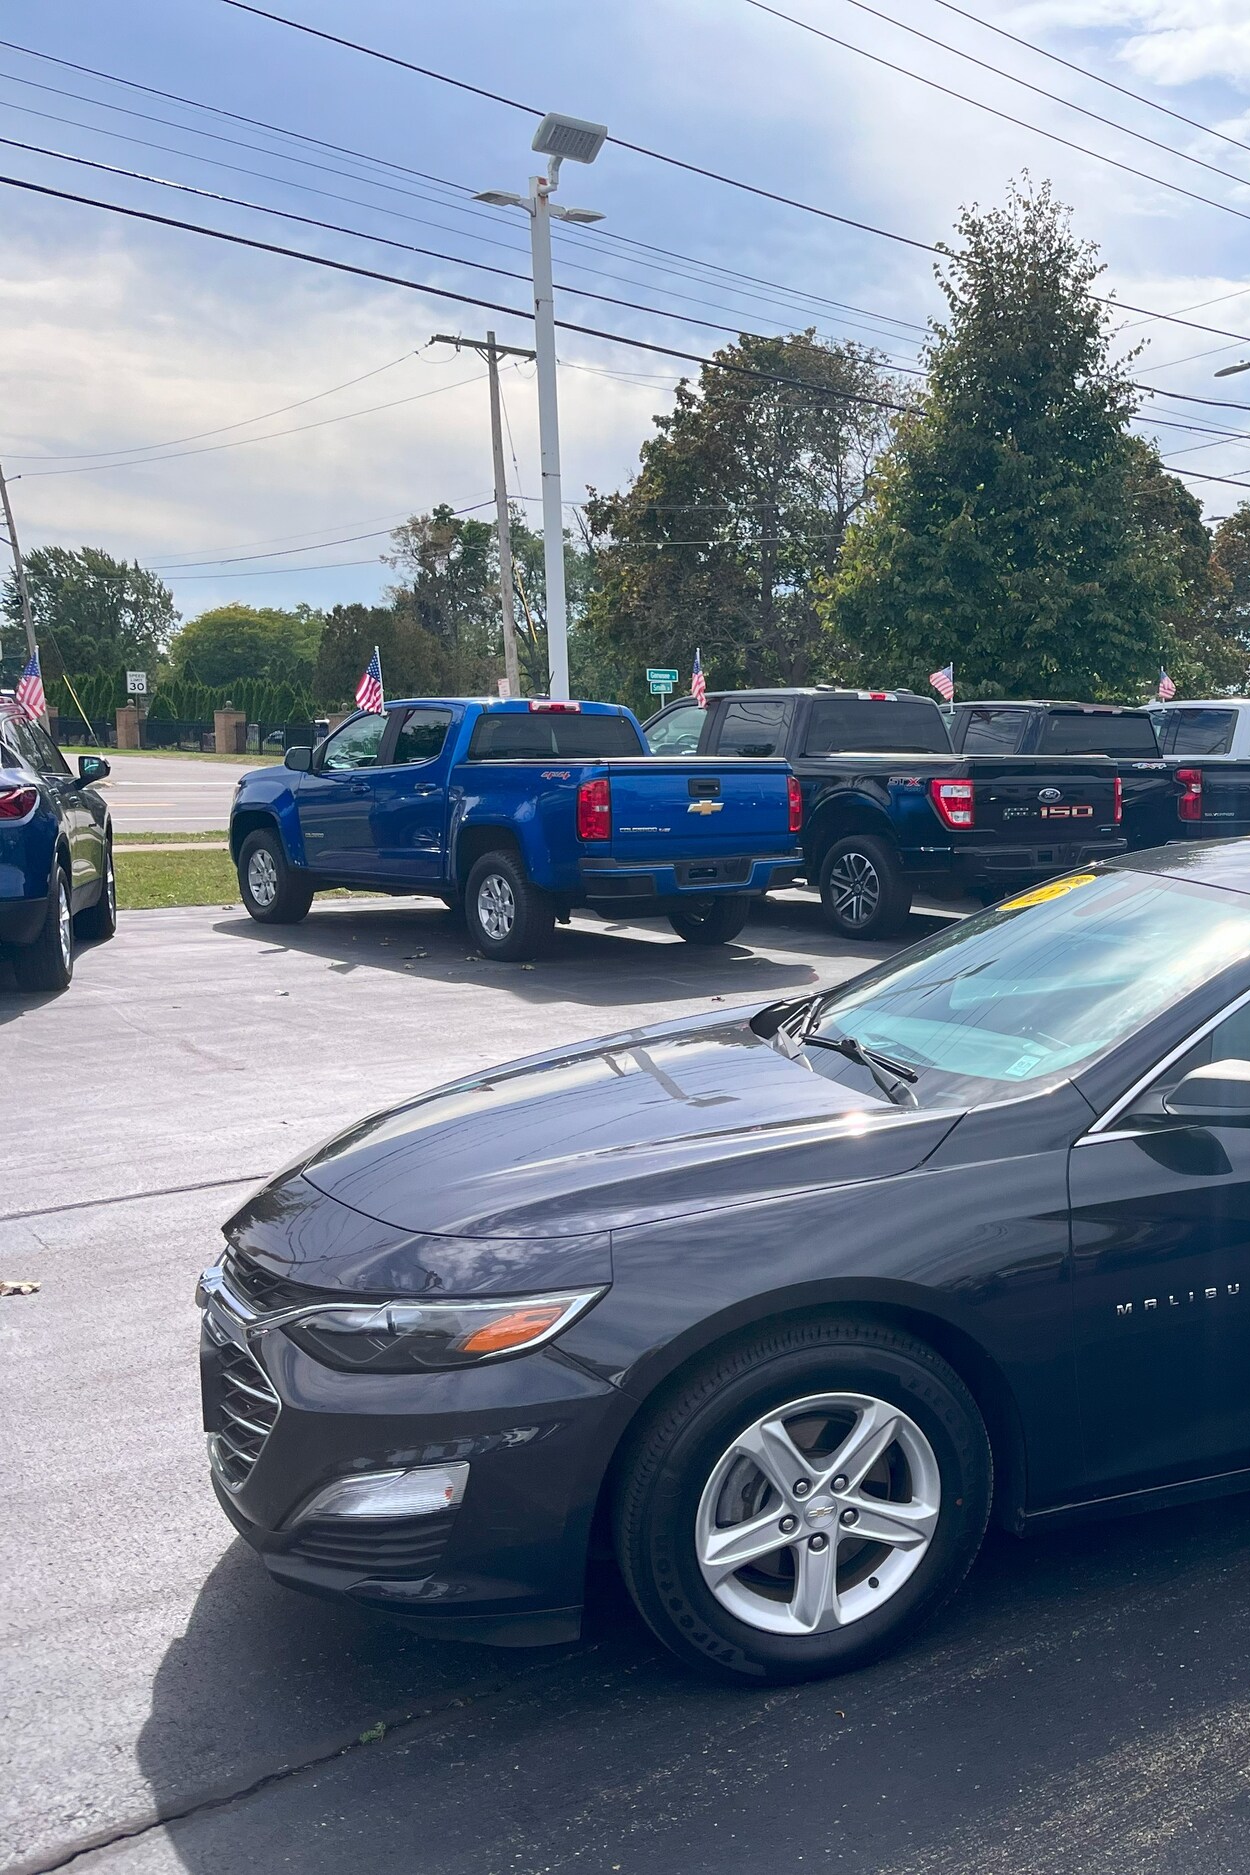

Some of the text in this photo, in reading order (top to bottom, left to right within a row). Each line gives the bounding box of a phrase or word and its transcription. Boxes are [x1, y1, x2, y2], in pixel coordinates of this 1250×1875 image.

[129, 682, 145, 691] 30
[1002, 805, 1093, 820] F-150
[1116, 1283, 1240, 1316] MALIBU
